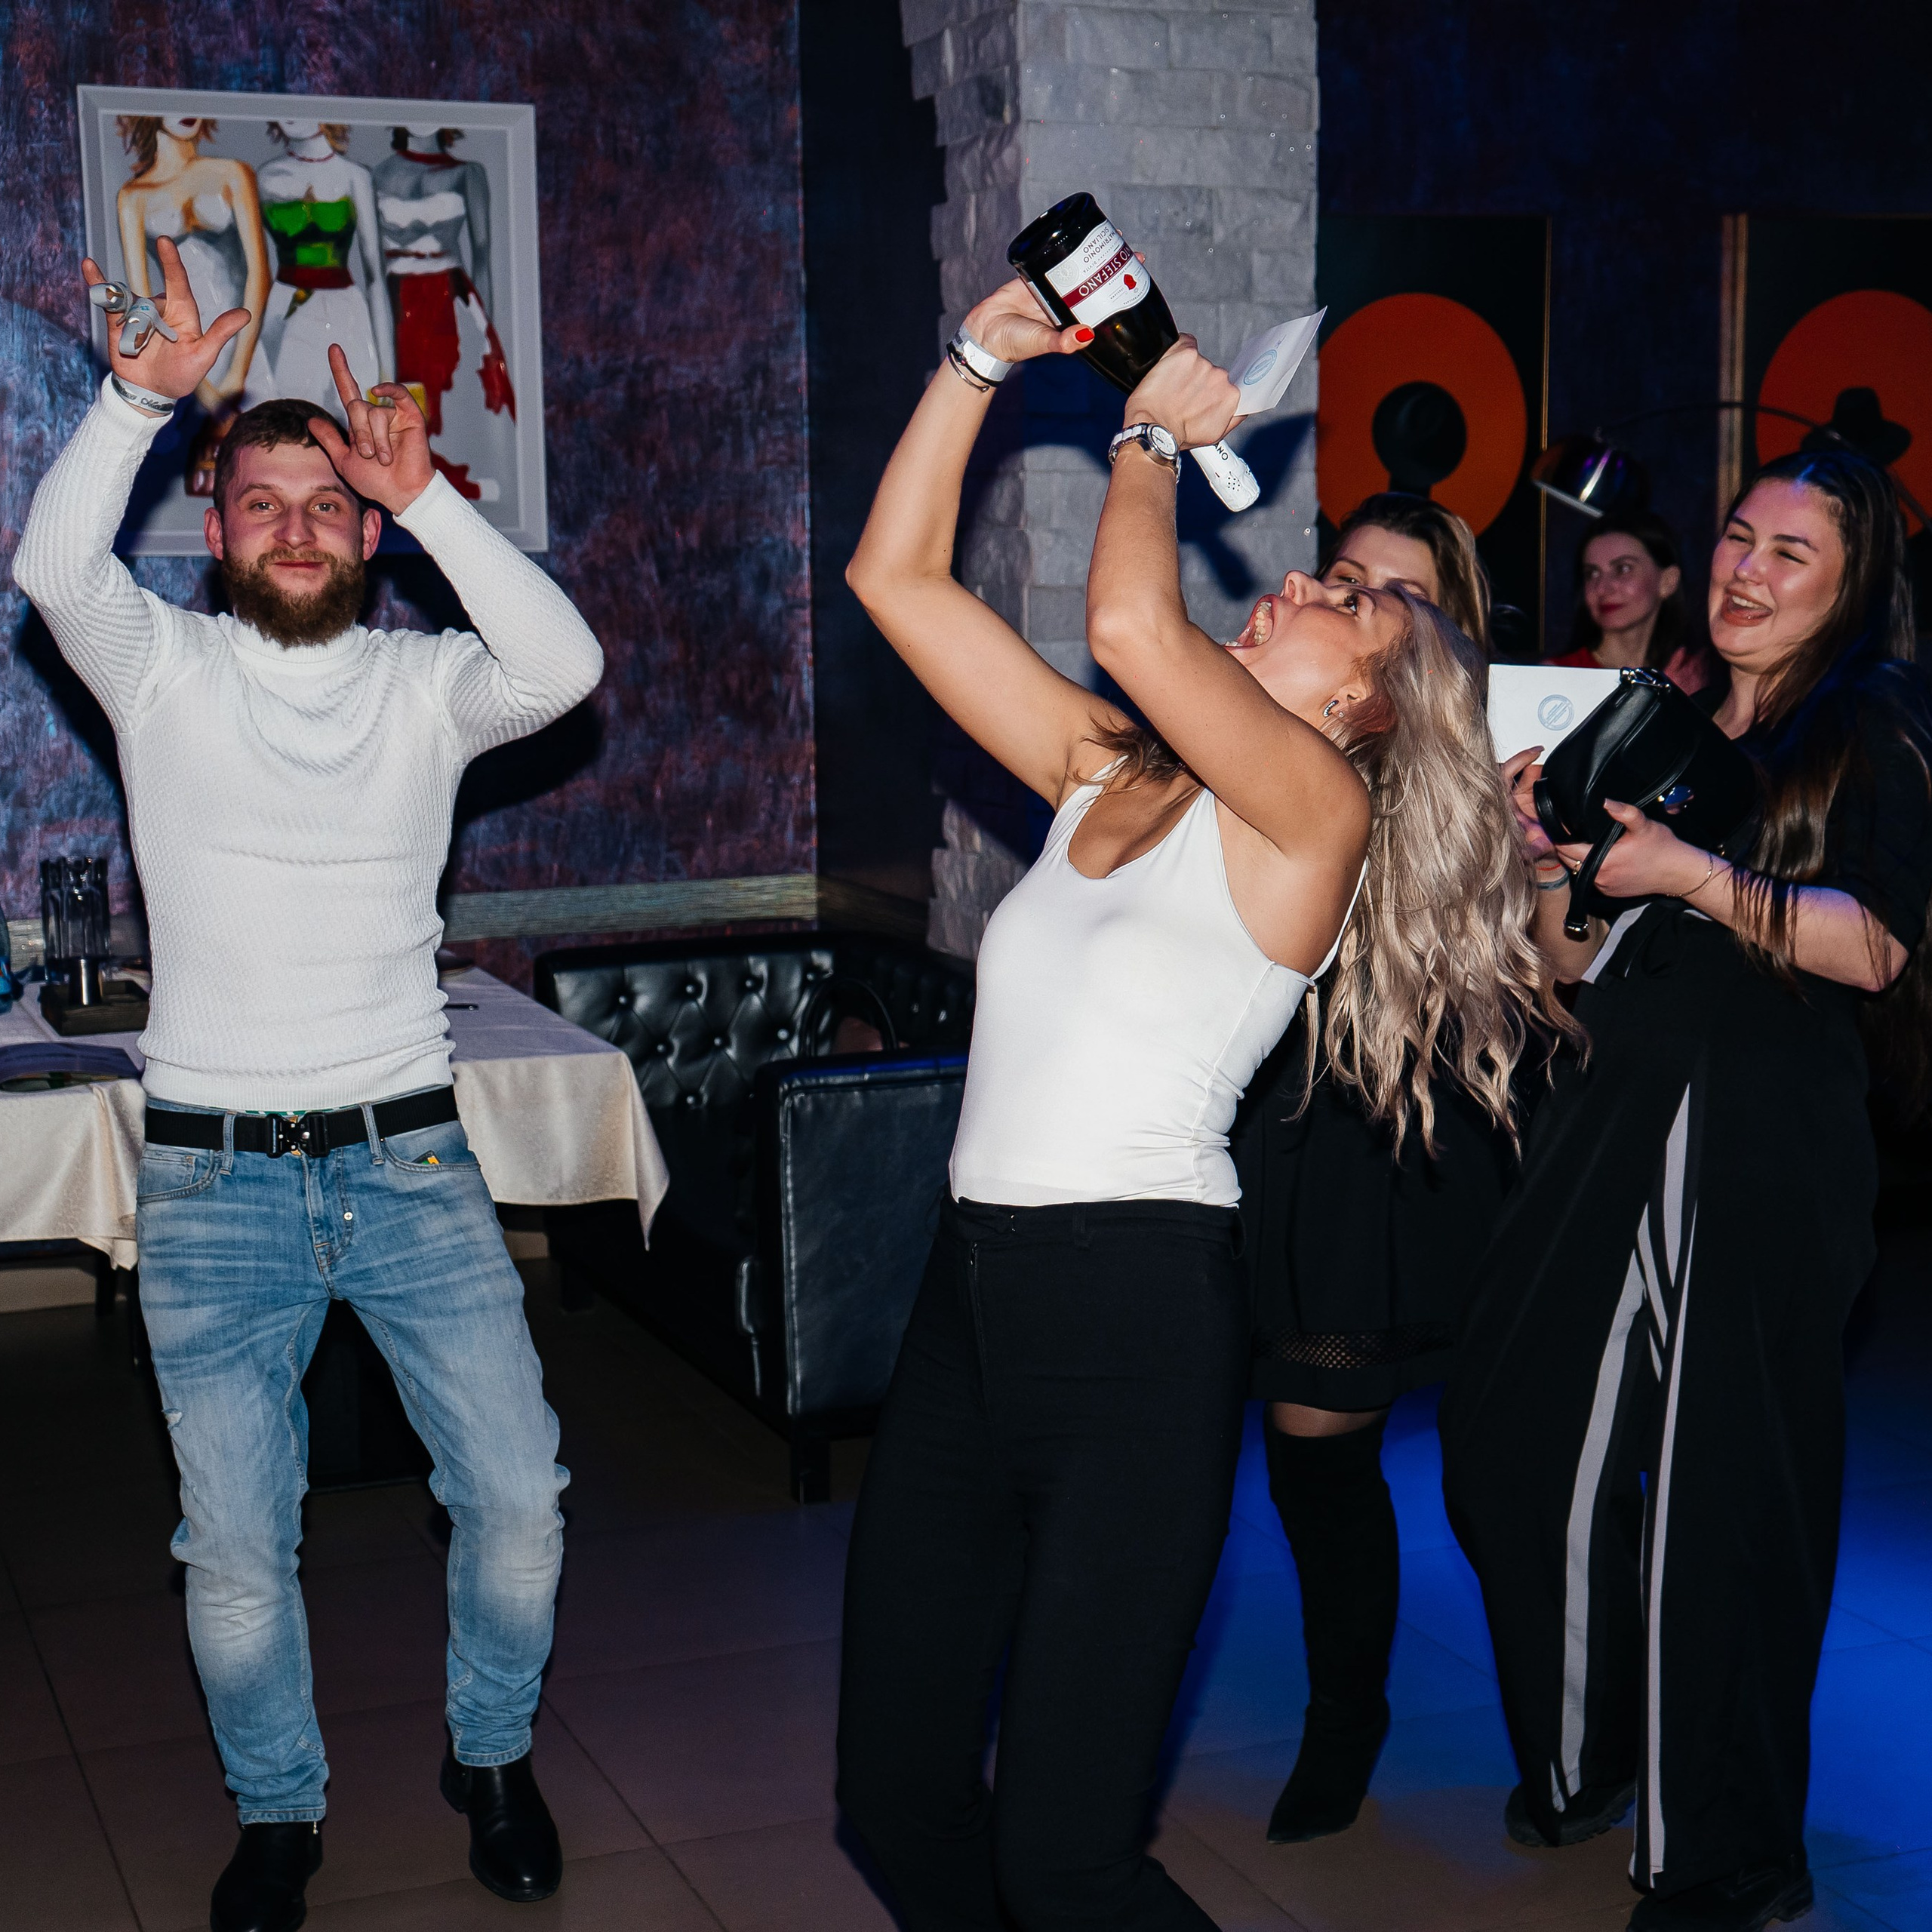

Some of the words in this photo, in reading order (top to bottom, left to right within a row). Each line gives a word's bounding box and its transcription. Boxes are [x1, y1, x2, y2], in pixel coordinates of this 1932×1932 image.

[1083, 226, 1109, 254] SICILIANO
[1083, 230, 1115, 263] MATRIMONIO
[1078, 257, 1121, 297] STEFANO
